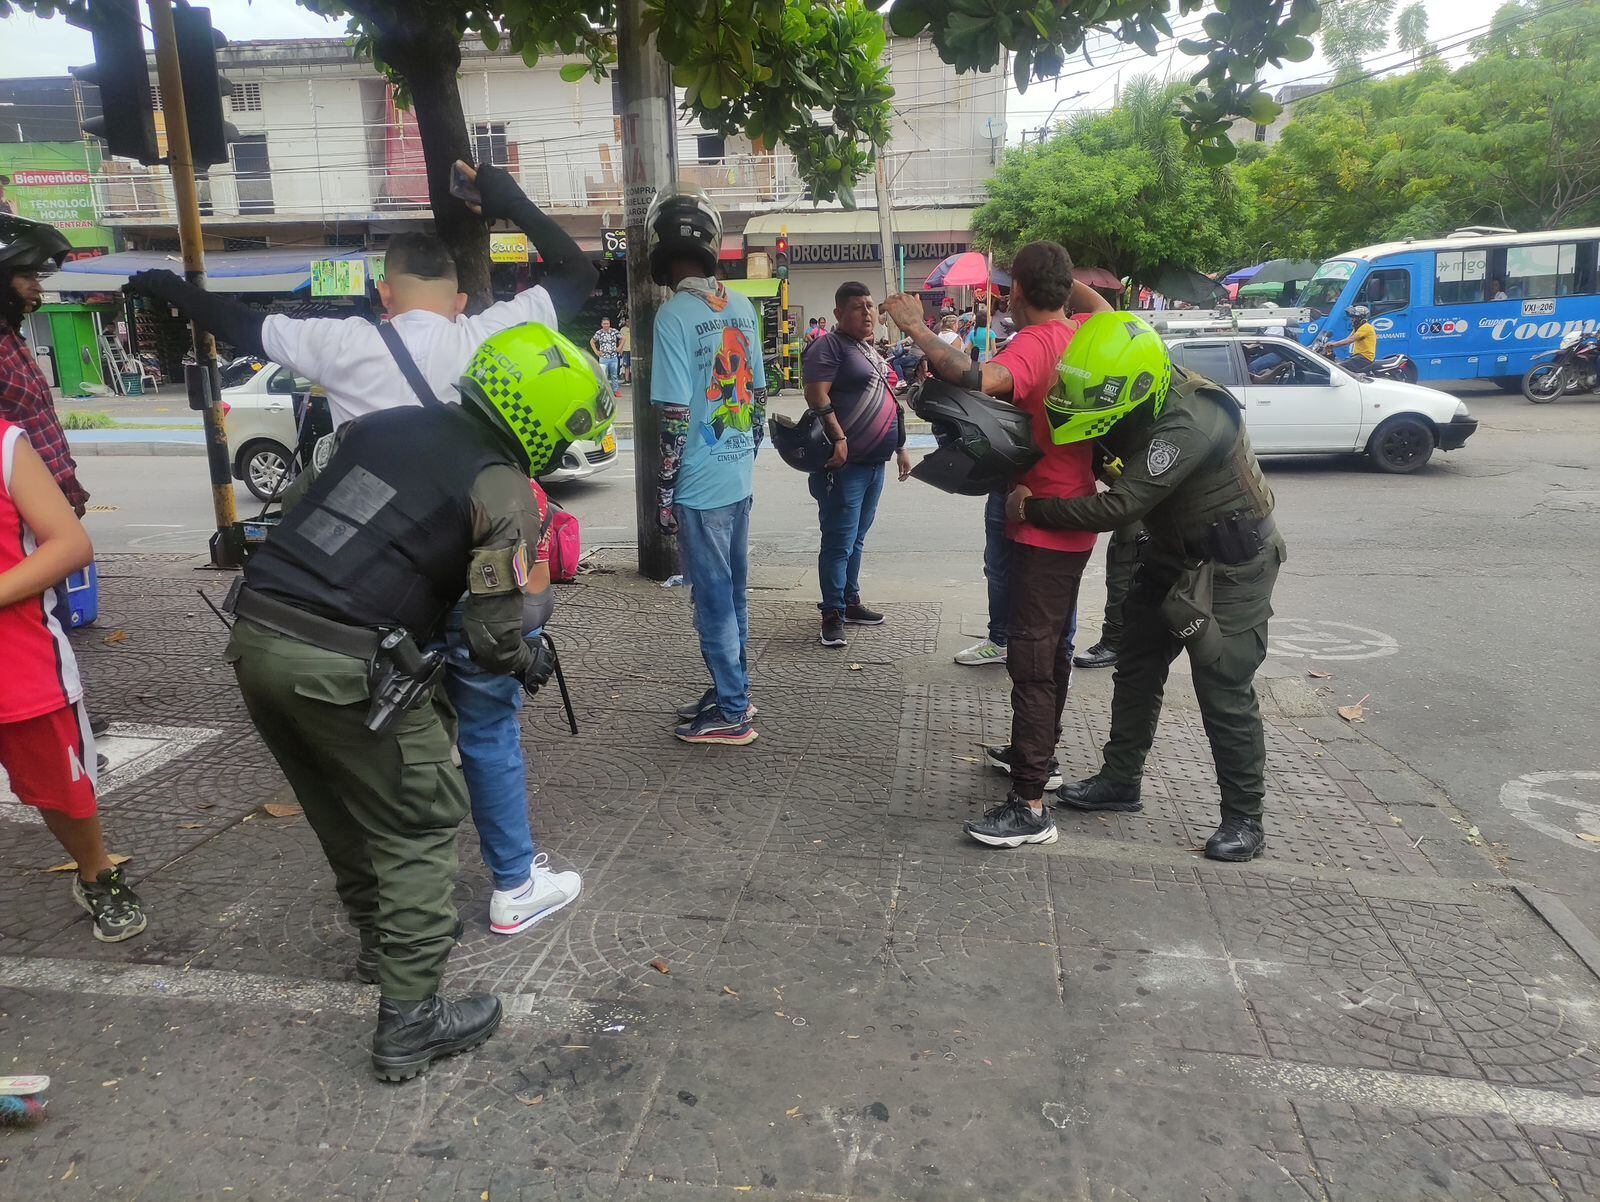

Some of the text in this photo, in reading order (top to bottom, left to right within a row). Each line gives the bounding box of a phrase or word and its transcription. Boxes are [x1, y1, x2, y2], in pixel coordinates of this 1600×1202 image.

[14, 171, 89, 184] Bienvenidos
[626, 186, 657, 197] COMPRA
[40, 209, 79, 220] HOGAR
[1491, 317, 1600, 341] Coom
[480, 343, 524, 384] POLICÍA
[1104, 384, 1118, 392] DOT
